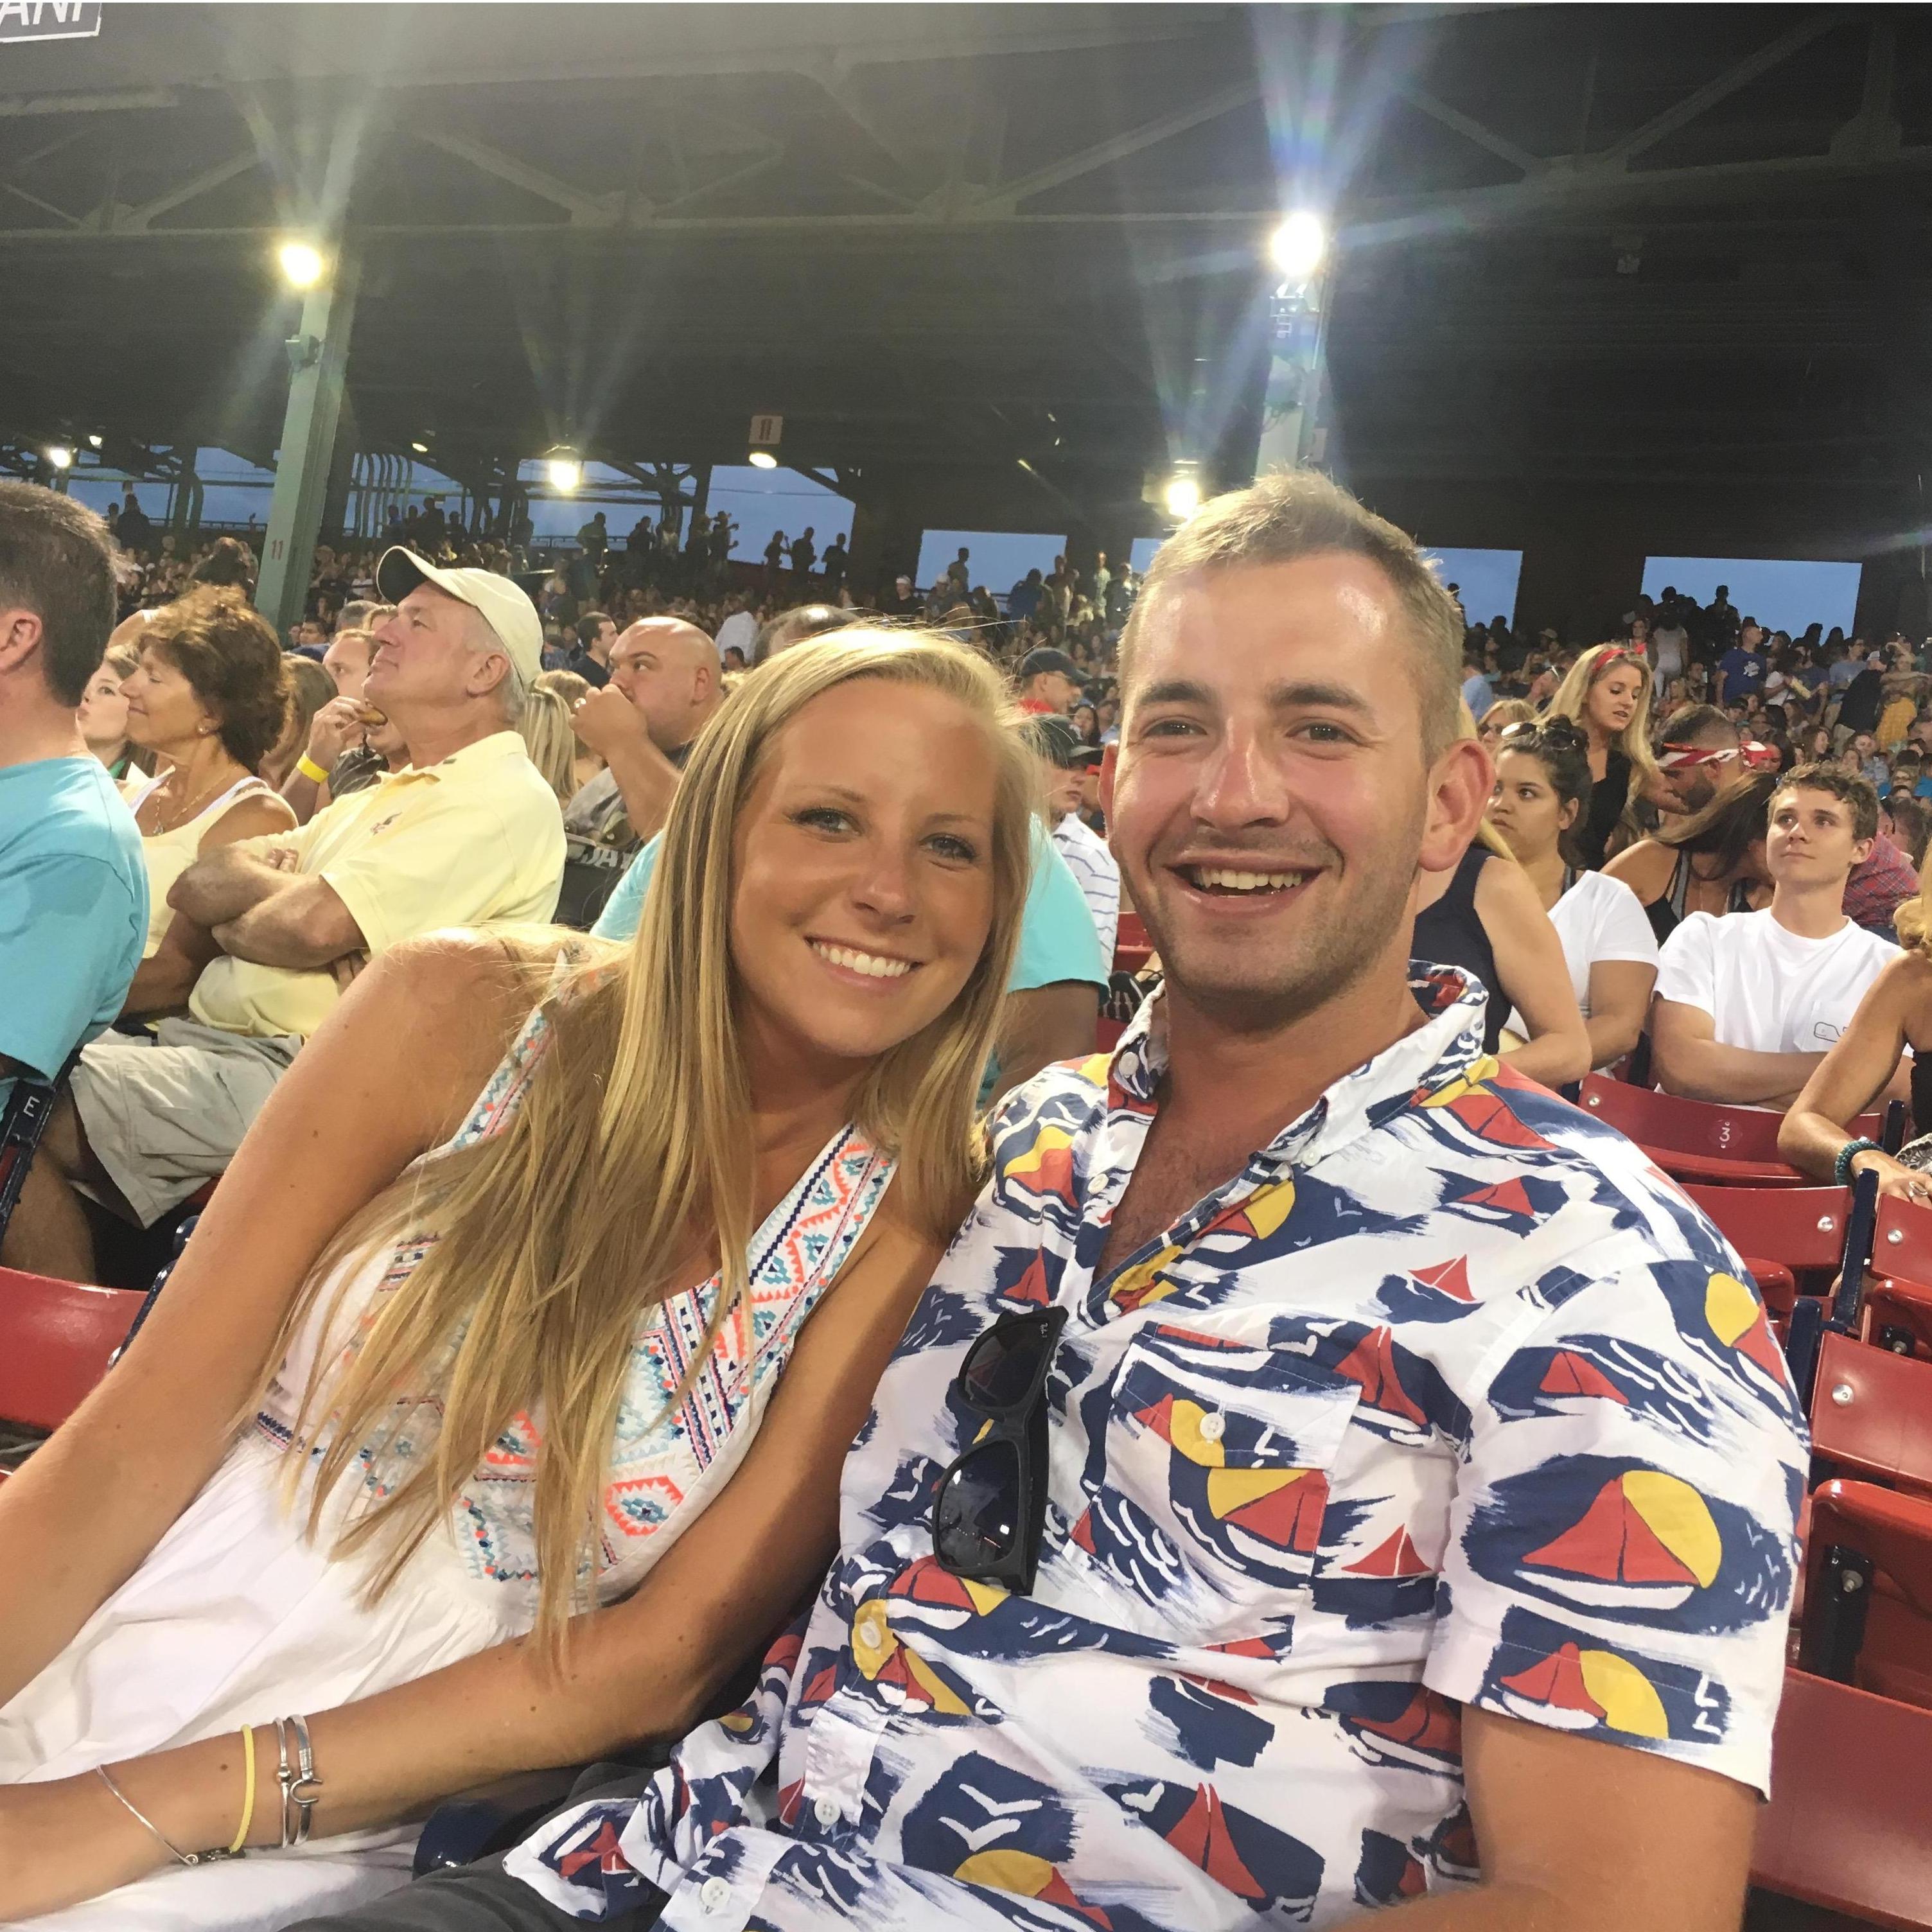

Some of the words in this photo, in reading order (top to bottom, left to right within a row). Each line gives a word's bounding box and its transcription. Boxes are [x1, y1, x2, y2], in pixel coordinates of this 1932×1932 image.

[271, 539, 283, 561] 11
[23, 1096, 40, 1118] E
[1719, 1126, 1730, 1142] 3
